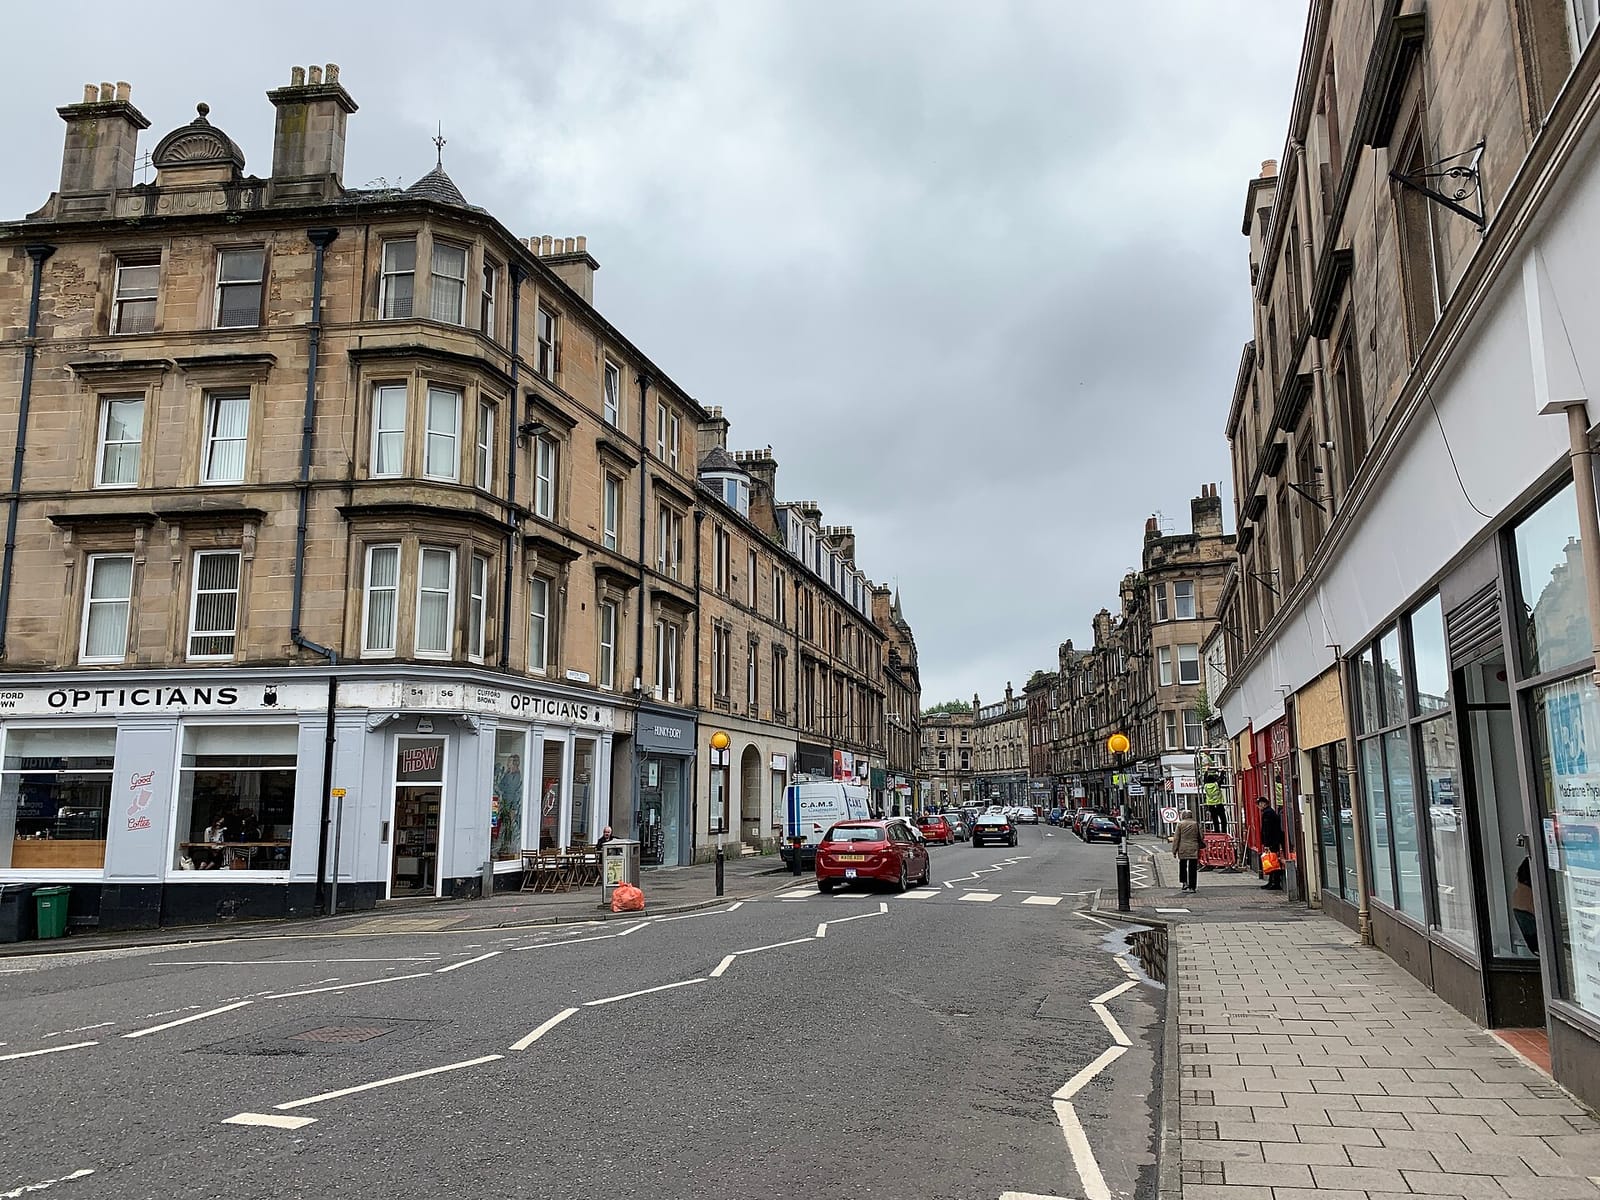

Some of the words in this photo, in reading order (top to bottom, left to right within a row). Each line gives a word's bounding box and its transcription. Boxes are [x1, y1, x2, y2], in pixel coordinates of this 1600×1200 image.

[0, 691, 24, 700] FORD
[47, 687, 239, 708] OPTICIANS
[410, 688, 424, 696] 54
[440, 689, 454, 697] 56
[477, 688, 501, 699] CLIFFORD
[477, 696, 496, 704] BROWN
[510, 694, 589, 720] OPTICIANS
[402, 745, 439, 774] HBW
[130, 770, 156, 791] Good
[801, 801, 834, 809] C.A.M.S
[127, 815, 152, 831] Coffee
